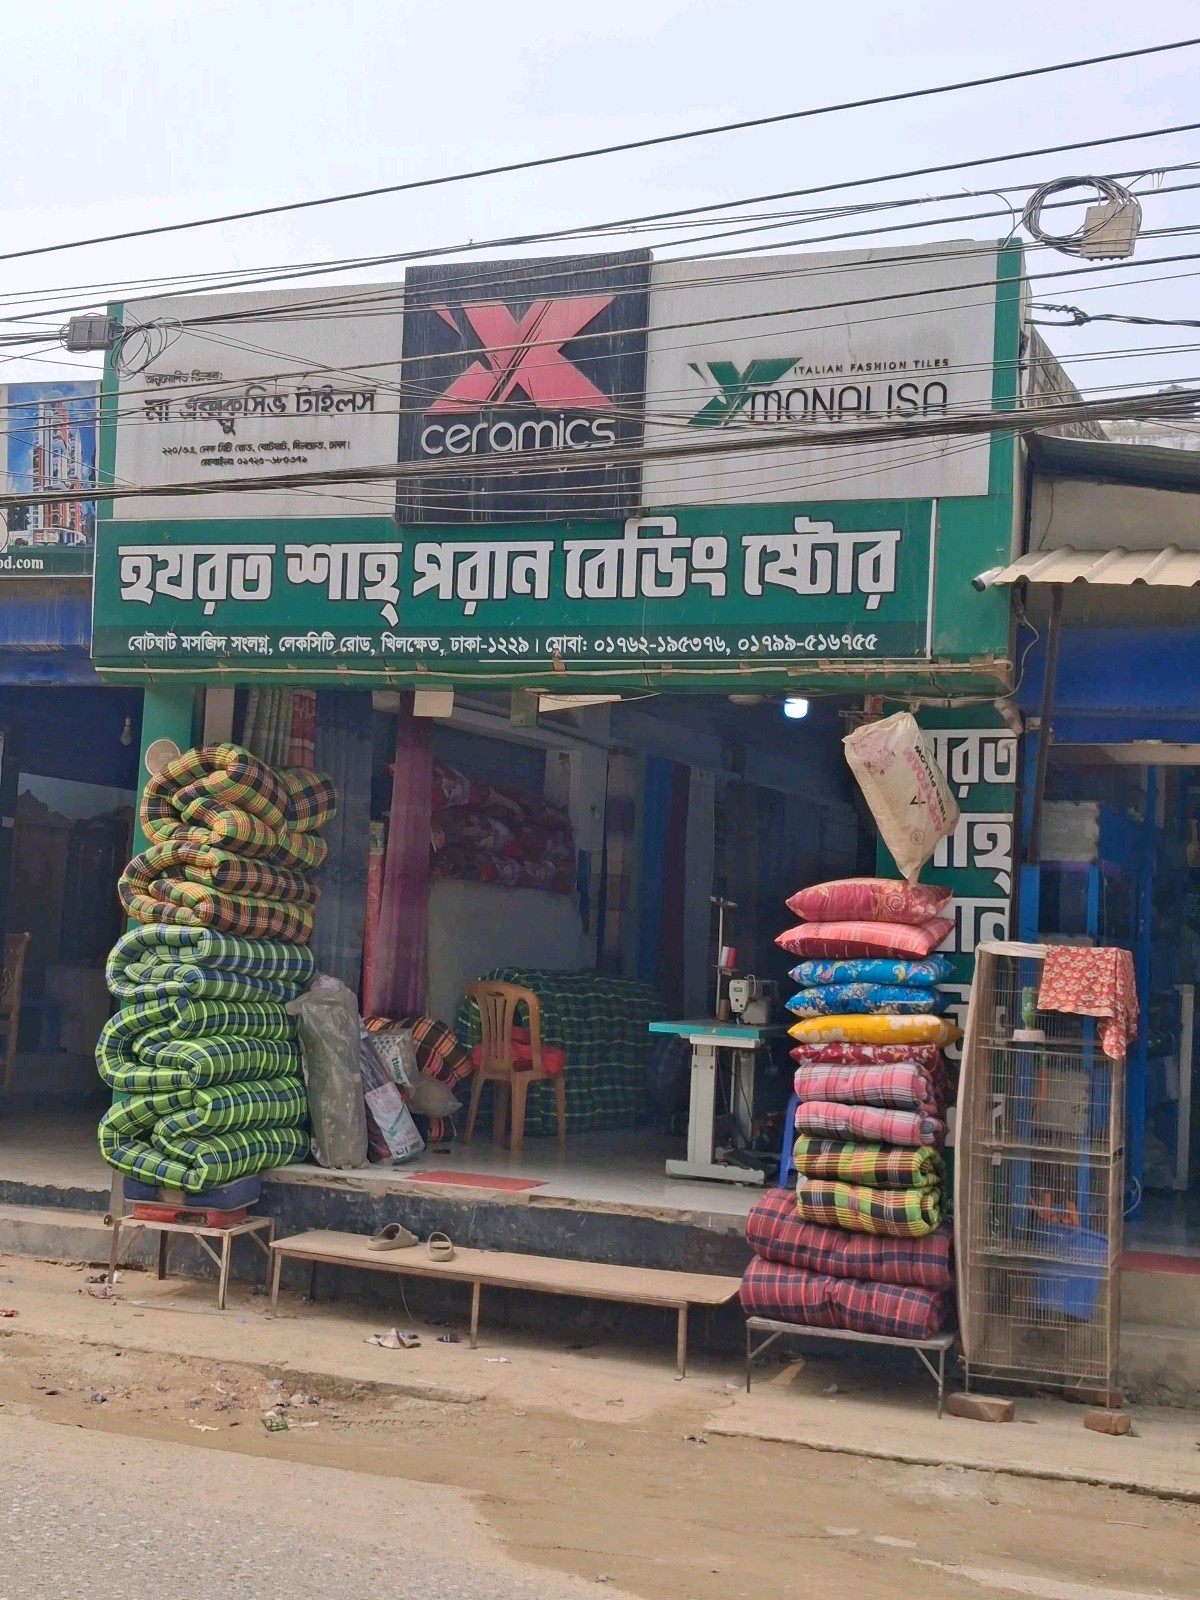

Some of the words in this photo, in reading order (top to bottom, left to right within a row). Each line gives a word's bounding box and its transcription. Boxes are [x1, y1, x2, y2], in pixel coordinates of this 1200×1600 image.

[794, 364, 844, 375] ITALIAN
[850, 361, 907, 372] FASHION
[913, 358, 949, 368] TILES
[294, 384, 377, 413] টাইলস
[750, 381, 948, 422] MONALISA
[420, 413, 617, 455] ceramics
[118, 544, 276, 616] হযরত
[284, 543, 402, 627] শাহ্
[413, 541, 554, 616] পরান
[563, 517, 728, 600] বেডিং
[741, 516, 901, 610] ষ্টোর
[128, 631, 178, 652] বোটঘাট
[180, 631, 228, 653] মসজিদ
[230, 634, 273, 655] সংলগ্ন,
[279, 632, 336, 652] লেকসিটি
[340, 636, 375, 656] রোড,
[380, 631, 445, 657] খিলক্ষেত,
[449, 636, 529, 655] ঢাকা-১২২৯
[594, 636, 731, 656] ০১৭৬২-১৯৫৩৭৬,
[738, 633, 878, 652] ০১৭৯৯-৫১৬৭৫৫
[914, 745, 937, 788] PILLOW
